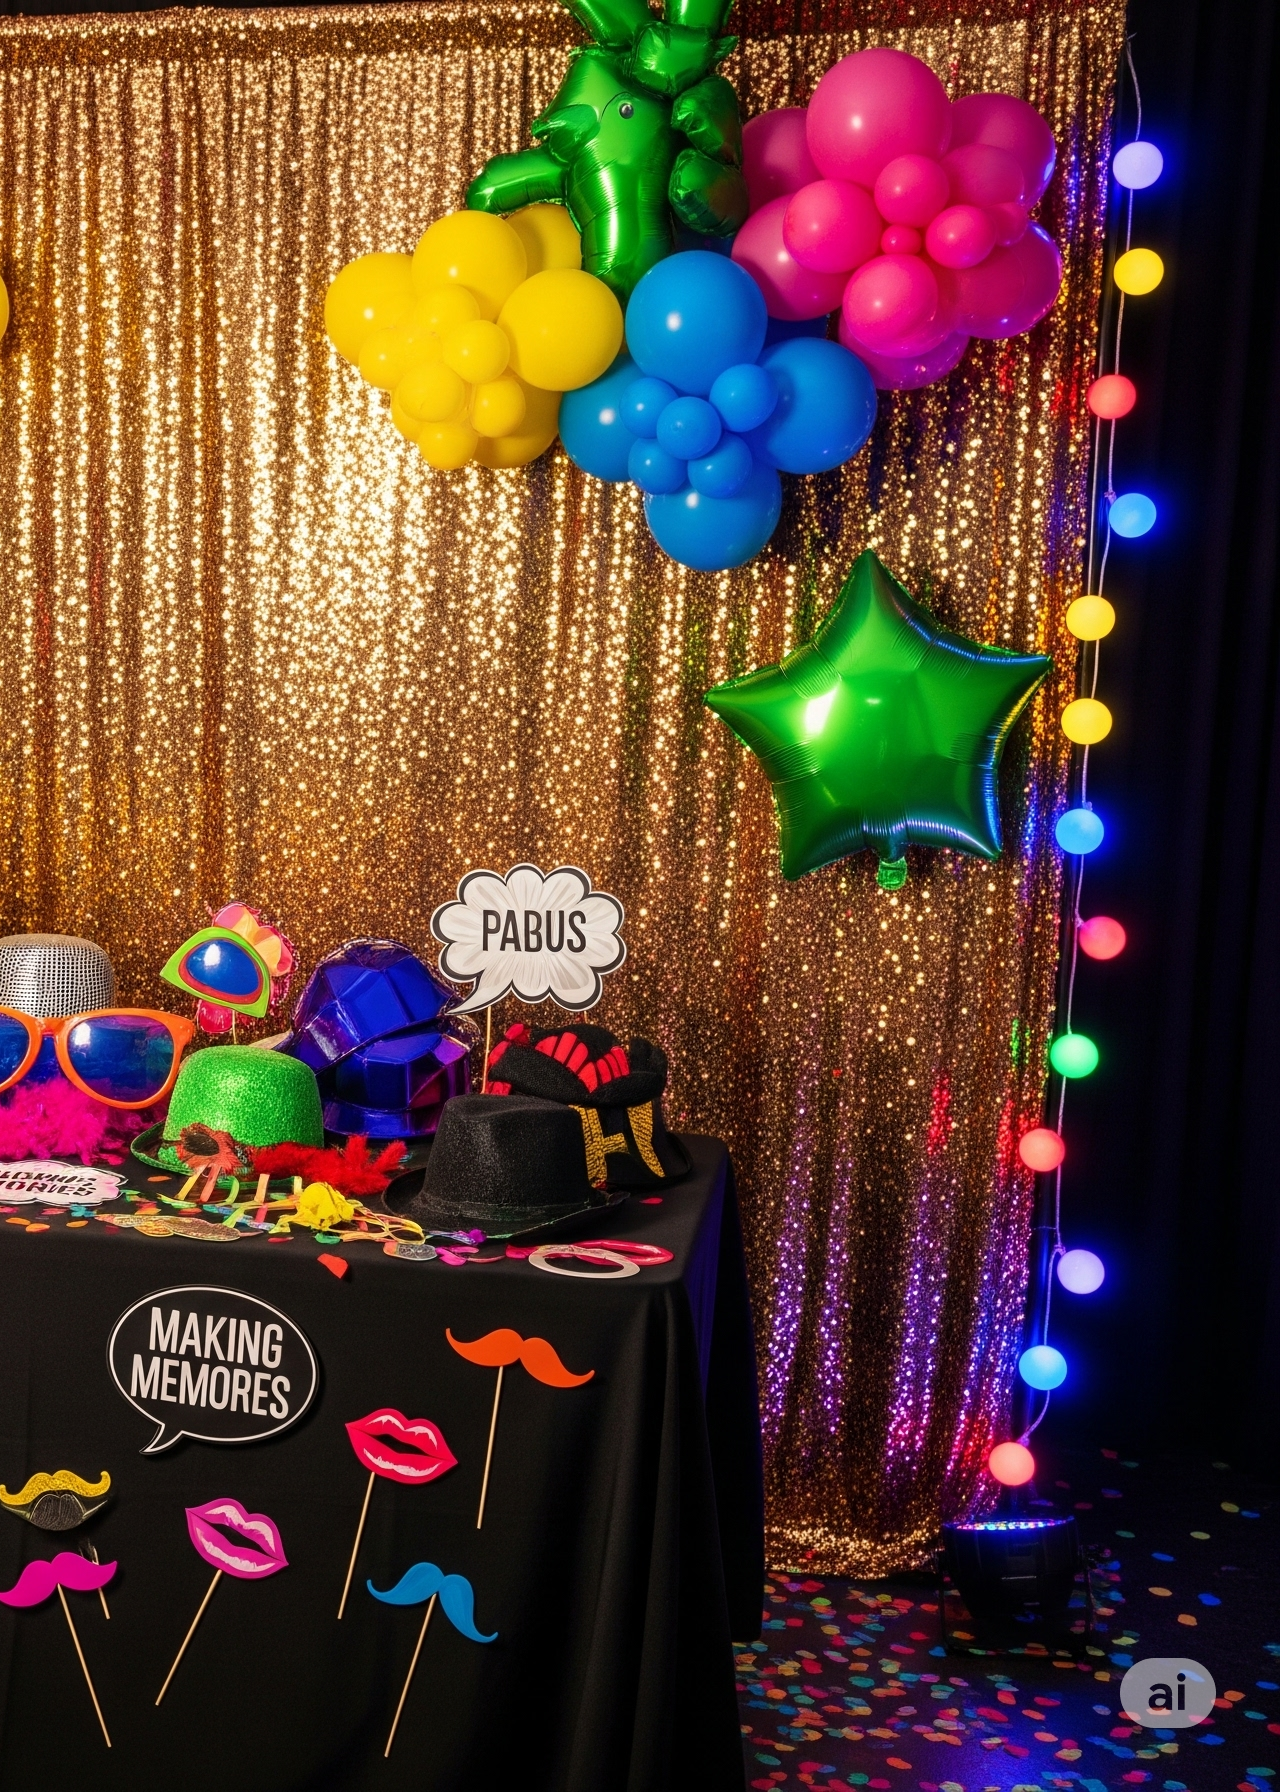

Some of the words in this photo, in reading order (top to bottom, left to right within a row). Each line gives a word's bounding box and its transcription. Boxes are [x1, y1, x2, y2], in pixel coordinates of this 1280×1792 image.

[482, 909, 587, 953] PABUS
[149, 1306, 284, 1369] MAKING
[130, 1353, 291, 1420] MEMORES
